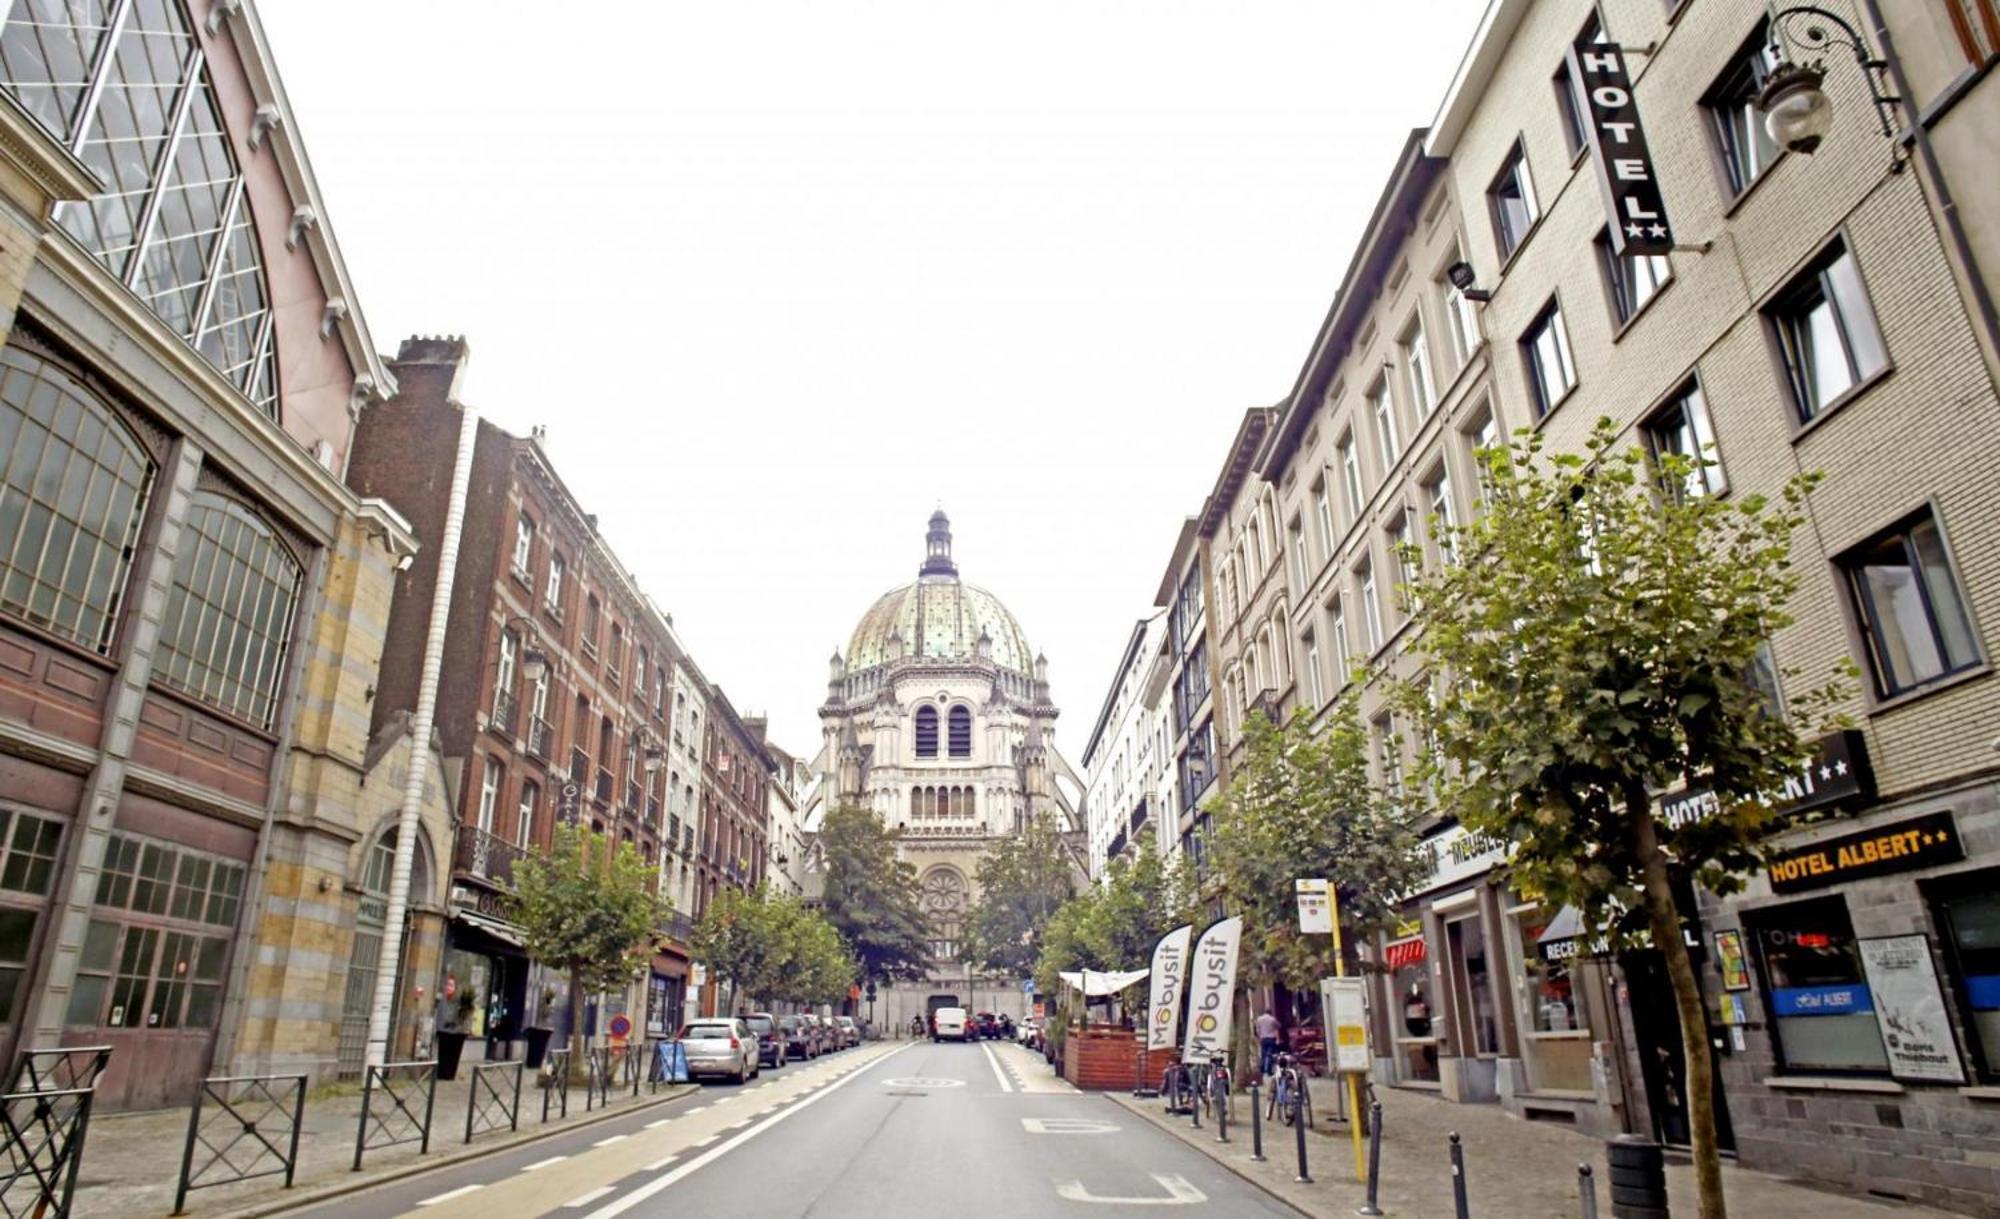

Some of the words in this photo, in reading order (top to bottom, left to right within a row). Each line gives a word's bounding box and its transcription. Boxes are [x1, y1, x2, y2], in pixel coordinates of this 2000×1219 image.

[1583, 52, 1659, 219] HOTEL
[1771, 852, 1834, 883] HOTEL
[1838, 830, 1920, 869] ALBERT
[1152, 944, 1180, 1046] Mobysit
[1190, 937, 1228, 1058] Mobysit
